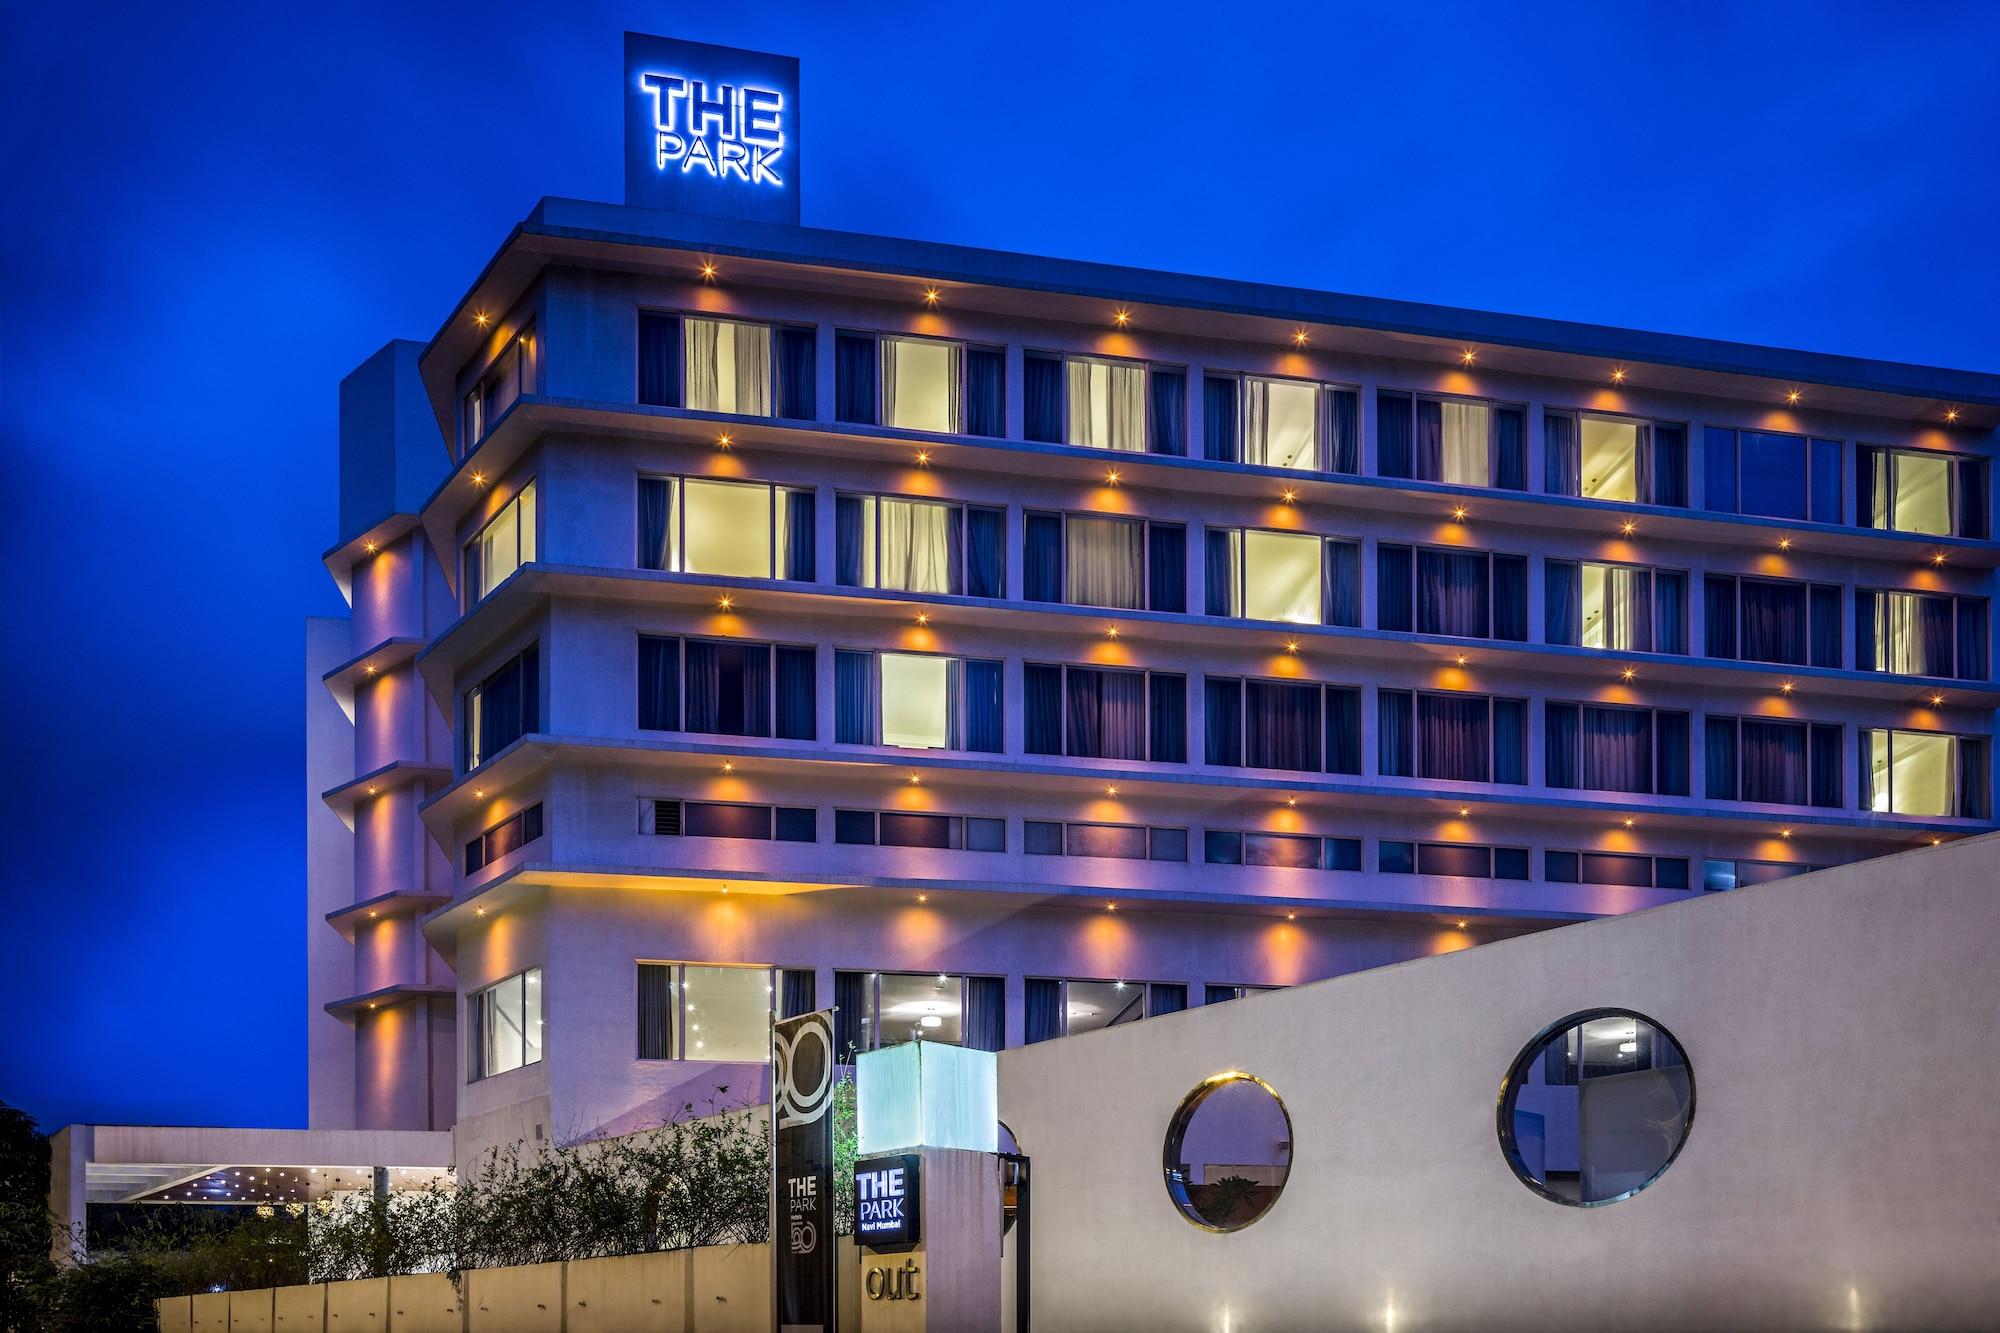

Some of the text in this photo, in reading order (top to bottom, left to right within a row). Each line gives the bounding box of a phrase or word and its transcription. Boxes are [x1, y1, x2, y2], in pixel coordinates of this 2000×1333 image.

[642, 73, 782, 148] THE
[657, 131, 783, 185] PARK
[787, 1175, 817, 1198] THE
[856, 1168, 905, 1200] THE
[790, 1197, 817, 1212] PARK
[860, 1198, 904, 1220] PARK
[861, 1220, 901, 1231] Navi Mumbai
[866, 1258, 920, 1301] out
